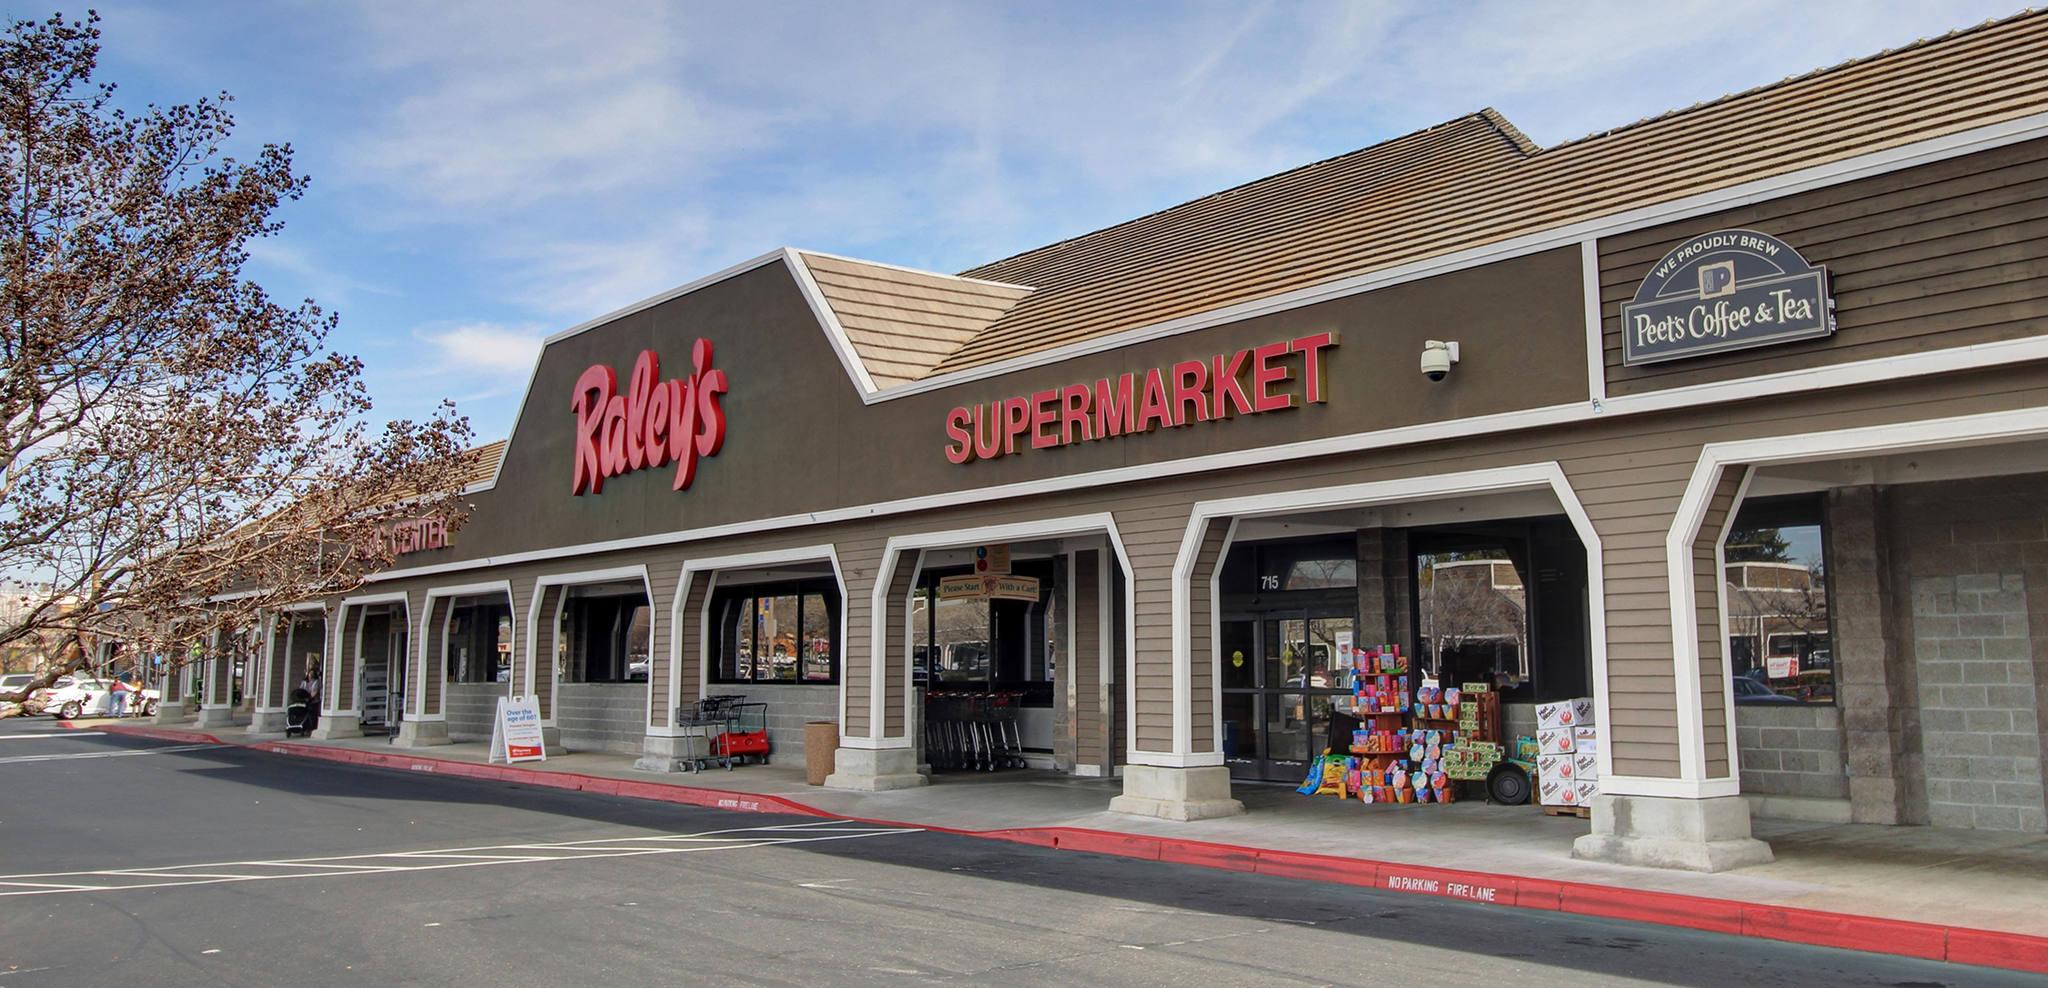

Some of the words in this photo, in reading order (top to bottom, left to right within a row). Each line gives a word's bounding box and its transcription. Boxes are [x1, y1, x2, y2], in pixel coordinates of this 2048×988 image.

[1656, 260, 1678, 279] WE
[1677, 235, 1738, 263] PROUDLY
[1740, 235, 1780, 256] BREW
[1634, 313, 1685, 347] Peet's
[1688, 301, 1750, 338] Coffee
[1754, 302, 1773, 324] &
[1769, 289, 1814, 324] Tea
[571, 337, 728, 497] Raley's
[945, 332, 1338, 465] SUPERMARKET
[944, 585, 962, 593] Please
[964, 583, 980, 591] Start
[999, 583, 1015, 591] With
[1261, 575, 1279, 590] 715
[1389, 876, 1400, 889] NO
[1401, 877, 1439, 892] PARKING
[1447, 883, 1469, 896] FIRE
[1470, 887, 1496, 901] LANE
